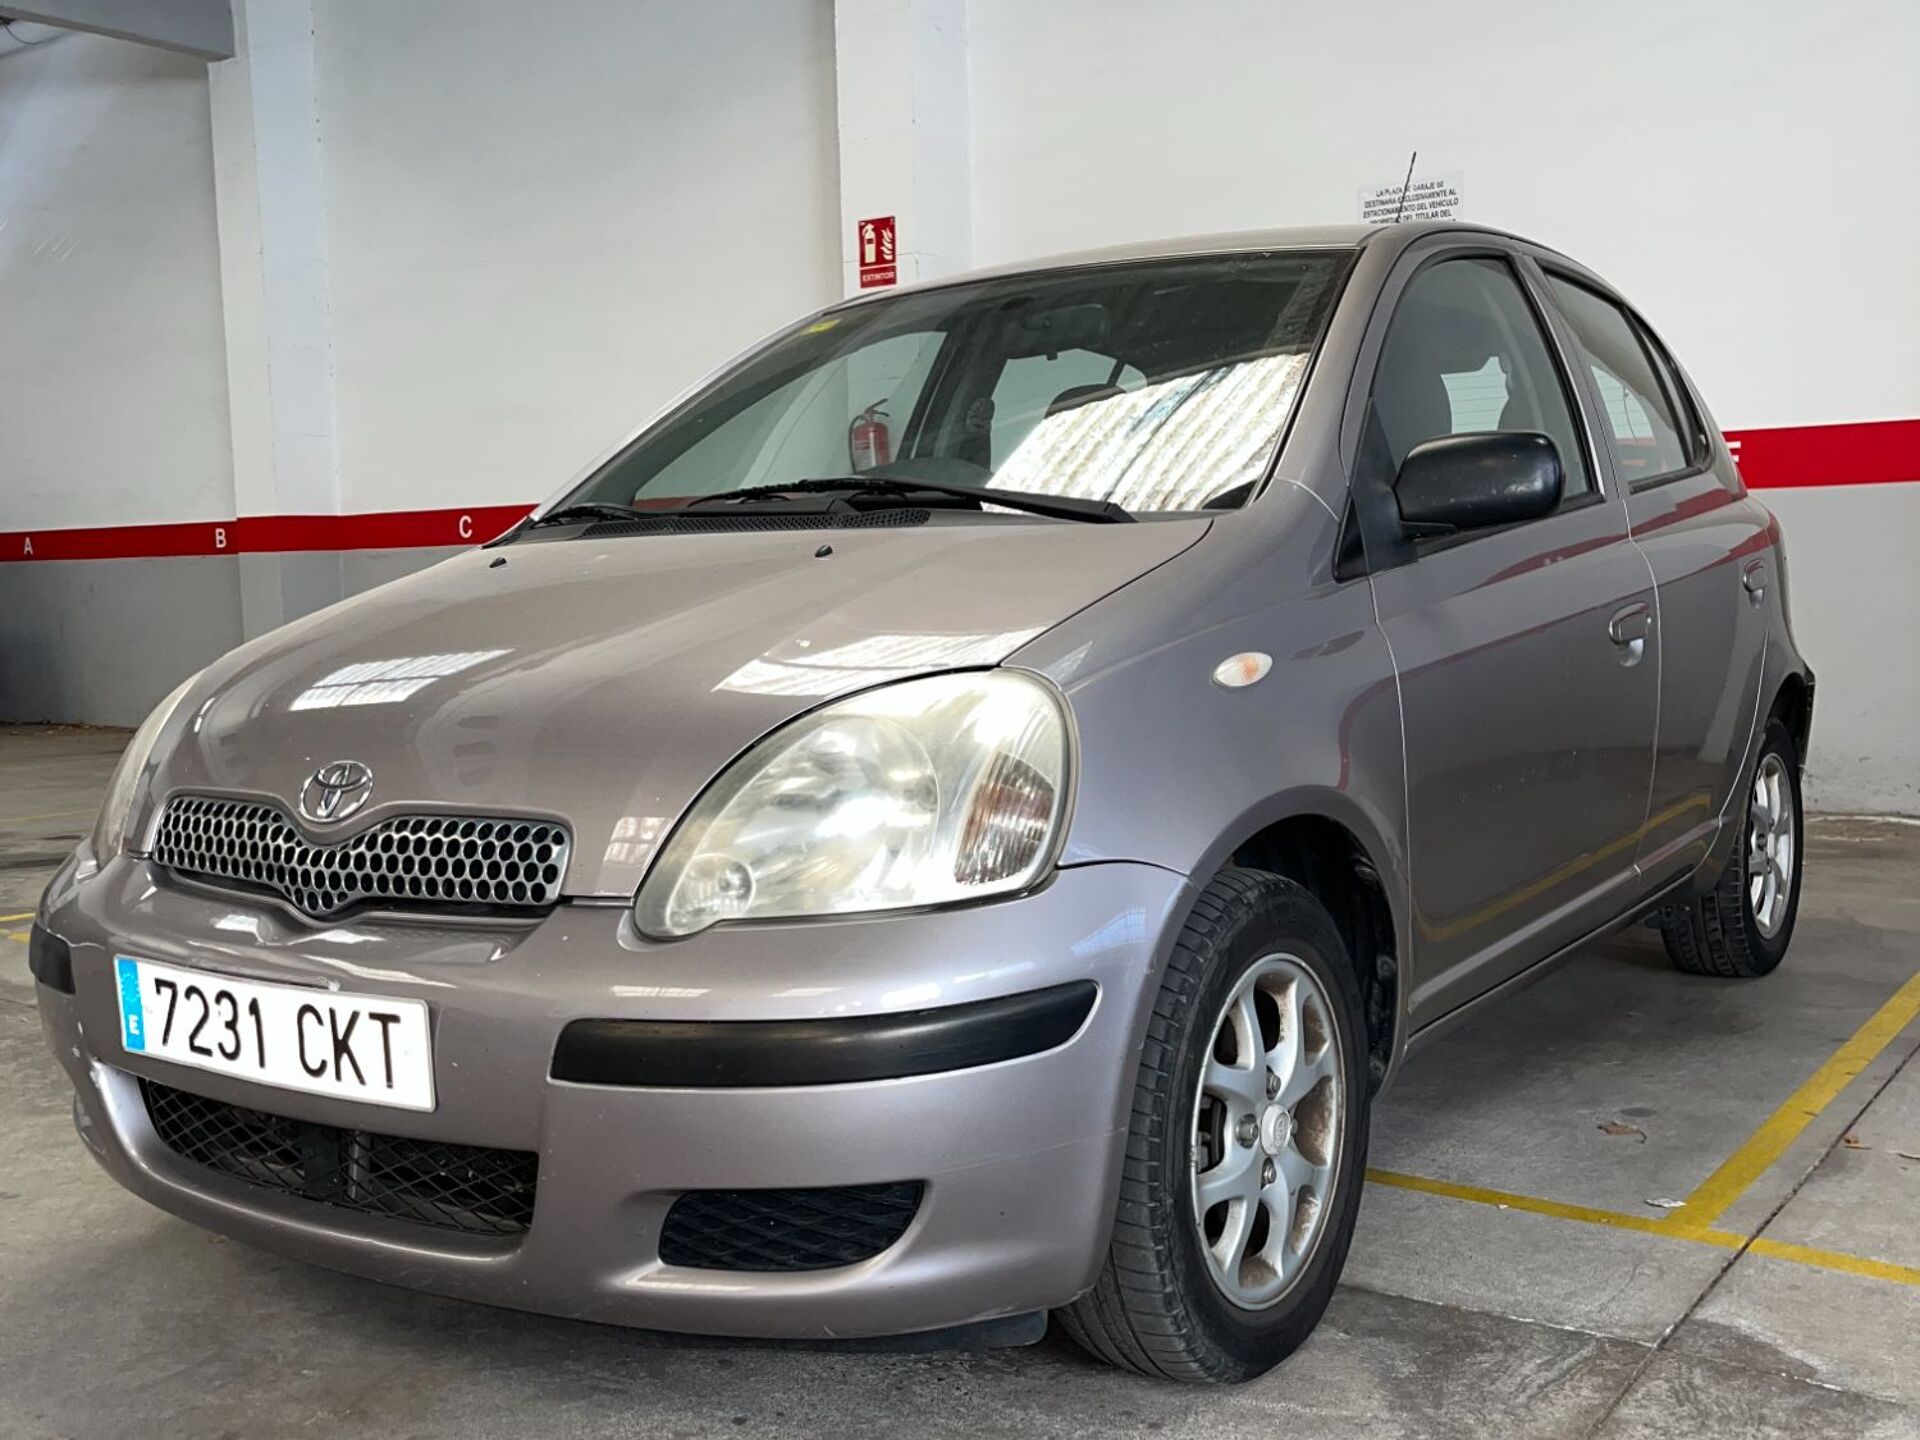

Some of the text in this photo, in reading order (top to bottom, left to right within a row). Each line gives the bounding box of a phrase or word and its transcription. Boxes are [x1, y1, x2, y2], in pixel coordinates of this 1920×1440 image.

[1449, 188, 1456, 196] AL
[1363, 206, 1416, 218] ESTACIONAMENTO
[1417, 203, 1428, 211] DEL
[1415, 210, 1440, 220] TITULAR
[1440, 208, 1452, 217] DEL
[862, 271, 894, 282] EXTINTOR
[458, 515, 473, 539] C
[23, 537, 34, 556] A
[215, 528, 227, 549] B
[129, 1015, 140, 1035] E
[154, 977, 401, 1089] 7231 CKT
